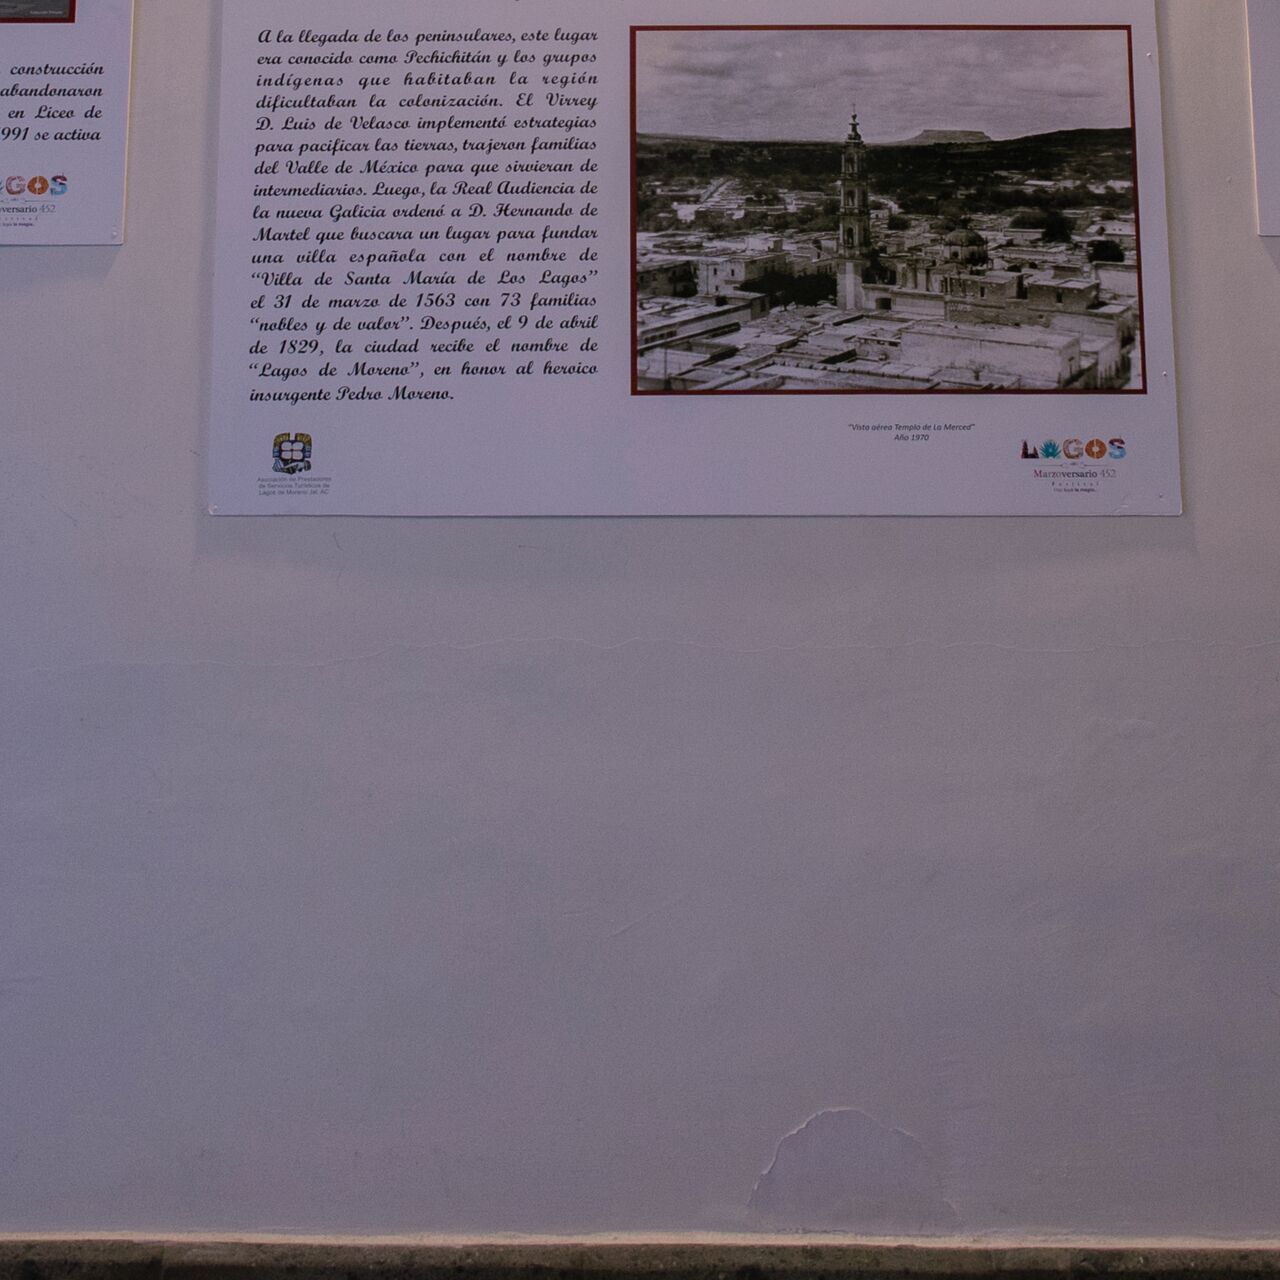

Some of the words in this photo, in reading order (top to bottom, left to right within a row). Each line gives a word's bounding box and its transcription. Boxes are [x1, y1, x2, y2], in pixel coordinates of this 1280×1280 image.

[256, 94, 357, 113] dificultaban
[369, 94, 386, 108] la
[399, 94, 503, 107] colonización.
[516, 93, 533, 107] El
[546, 92, 597, 110] Virrey
[251, 272, 302, 286] “Villa
[314, 272, 332, 286] de
[344, 271, 391, 285] Santa
[403, 270, 456, 285] María
[467, 270, 486, 284] de
[497, 270, 526, 284] Los
[539, 270, 598, 288] Lagos”
[249, 389, 331, 405] insurgente
[335, 386, 382, 400] Pedro
[388, 385, 454, 400] Moreno.
[1033, 469, 1098, 479] Marzoversario
